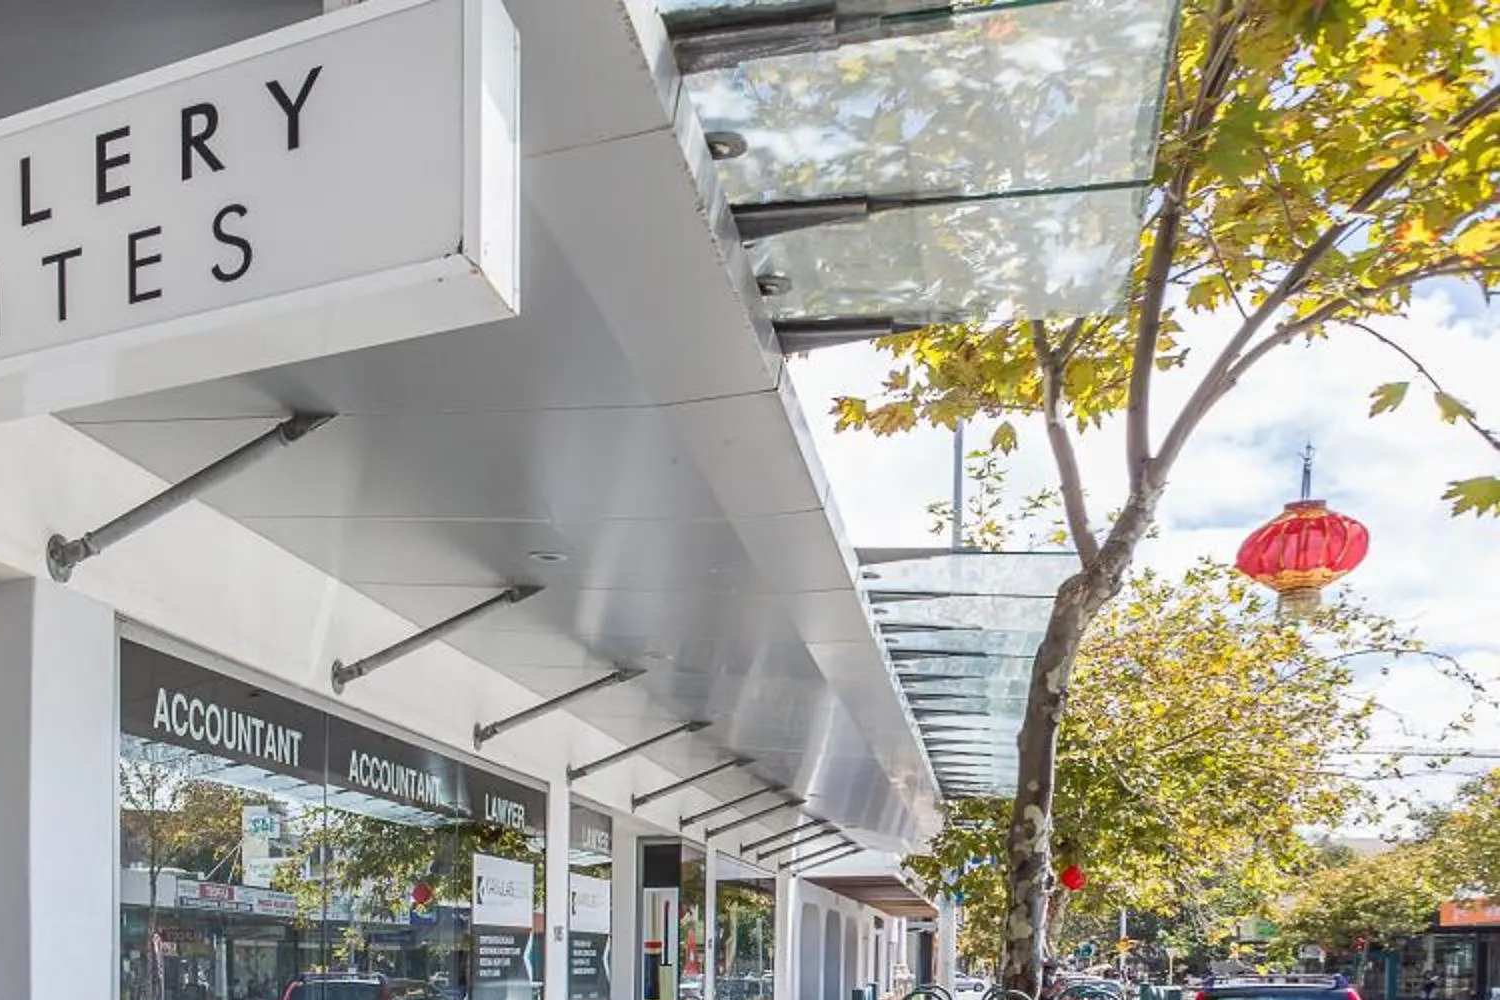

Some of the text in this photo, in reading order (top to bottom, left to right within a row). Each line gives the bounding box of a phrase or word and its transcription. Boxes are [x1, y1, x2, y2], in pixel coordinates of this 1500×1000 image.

[153, 687, 303, 767] ACCOUNTANT
[349, 750, 442, 806] ACCOUNTANT
[485, 793, 526, 829] LAWYER
